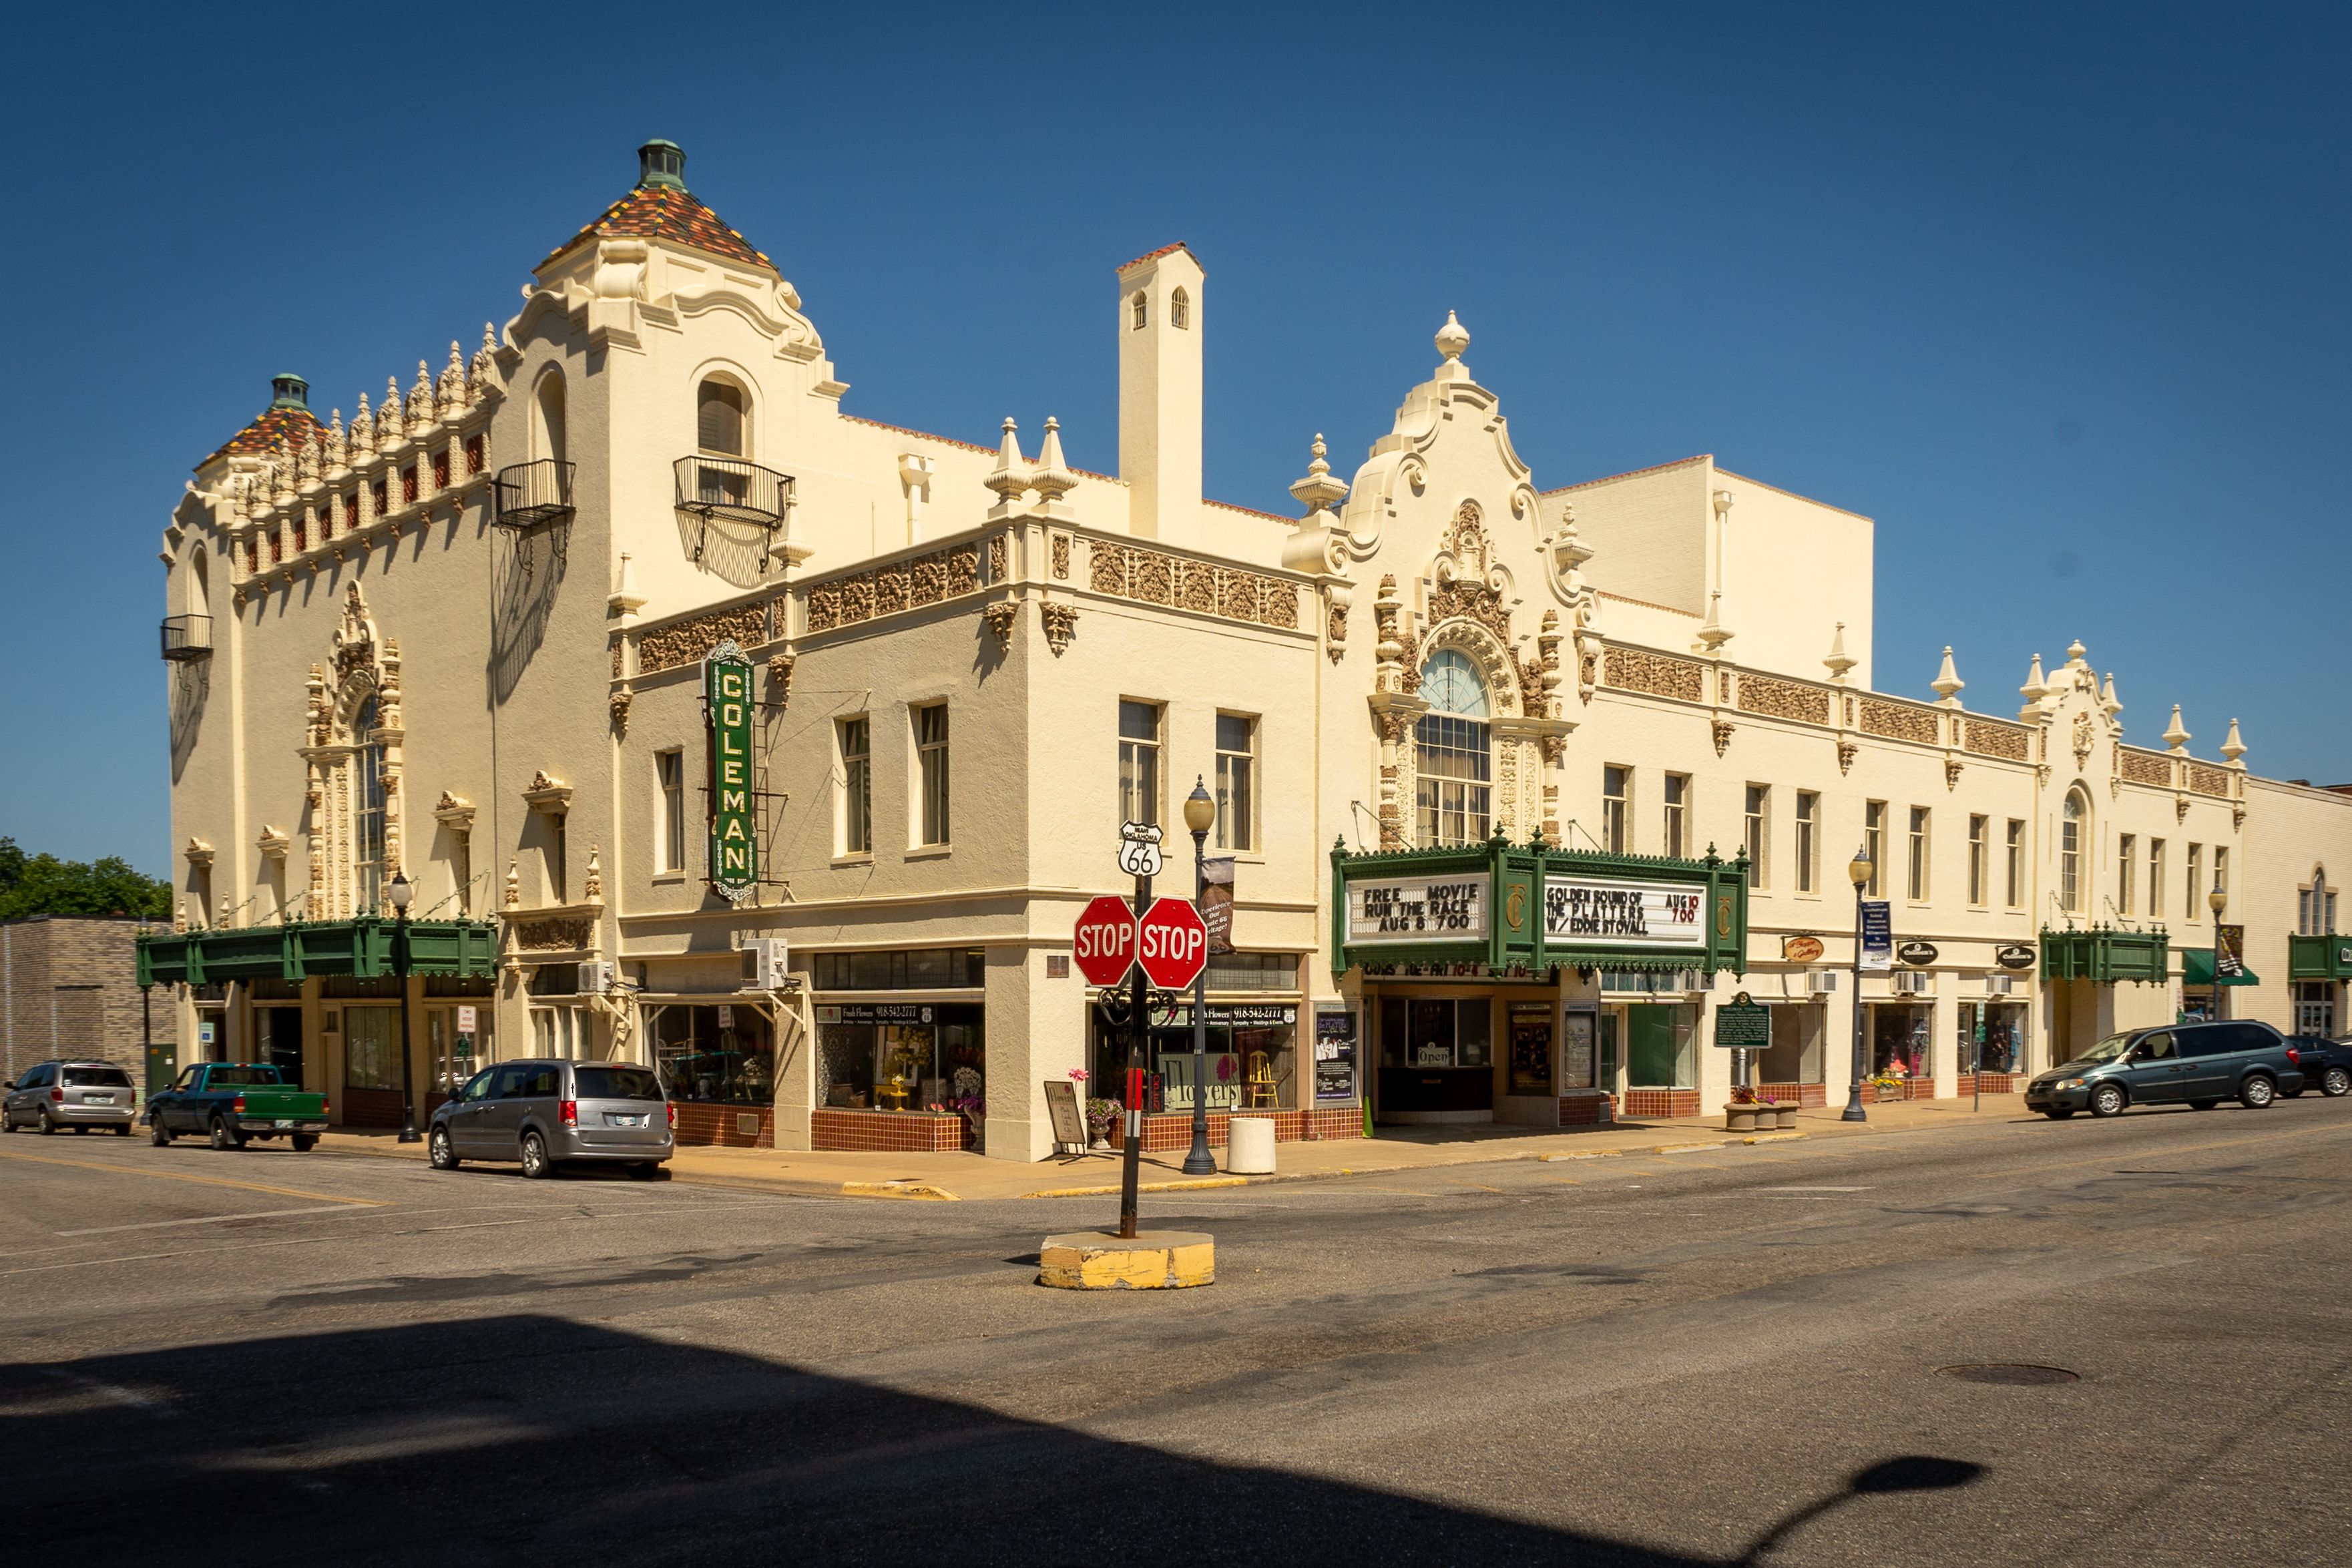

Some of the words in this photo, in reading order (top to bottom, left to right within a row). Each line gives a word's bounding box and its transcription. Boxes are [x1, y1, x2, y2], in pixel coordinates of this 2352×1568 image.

[722, 674, 745, 870] COLEMAN
[1125, 832, 1158, 841] OKLAHOMA
[1137, 842, 1146, 850] US
[1127, 848, 1153, 873] 66
[1364, 888, 1401, 902] FREE
[1427, 884, 1477, 900] MOVIE
[1546, 887, 1591, 902] GOLDEN
[1594, 890, 1627, 904] SOUND
[1629, 892, 1643, 906] OF
[1202, 901, 1231, 914] Experience
[1365, 903, 1392, 917] RUN
[1399, 901, 1425, 916] THE
[1430, 899, 1469, 915] RACE
[1666, 894, 1686, 908] AUG
[1689, 895, 1699, 909] 10
[1546, 902, 1565, 917] THE
[1572, 904, 1644, 921] PLATTERS
[1672, 908, 1695, 923] 700
[1206, 919, 1219, 927] oute
[1208, 923, 1228, 935] ritage!
[1379, 917, 1409, 932] AUG
[1416, 916, 1425, 931] 8
[1437, 914, 1469, 930] 700
[1570, 918, 1600, 934] EDDIE
[1602, 919, 1649, 935] STOVALL
[1078, 923, 1132, 957] STOP
[1143, 924, 1202, 960] STOP
[1365, 963, 1395, 976] OURS
[843, 1007, 855, 1017] Fresh
[857, 1007, 873, 1017] Flowers
[876, 1006, 917, 1017] 918-542-2777
[1208, 1007, 1230, 1019] Flowers
[1234, 1007, 1281, 1019] 918-542-2777
[1419, 1051, 1448, 1064] Open
[1164, 1060, 1236, 1102] Floers
